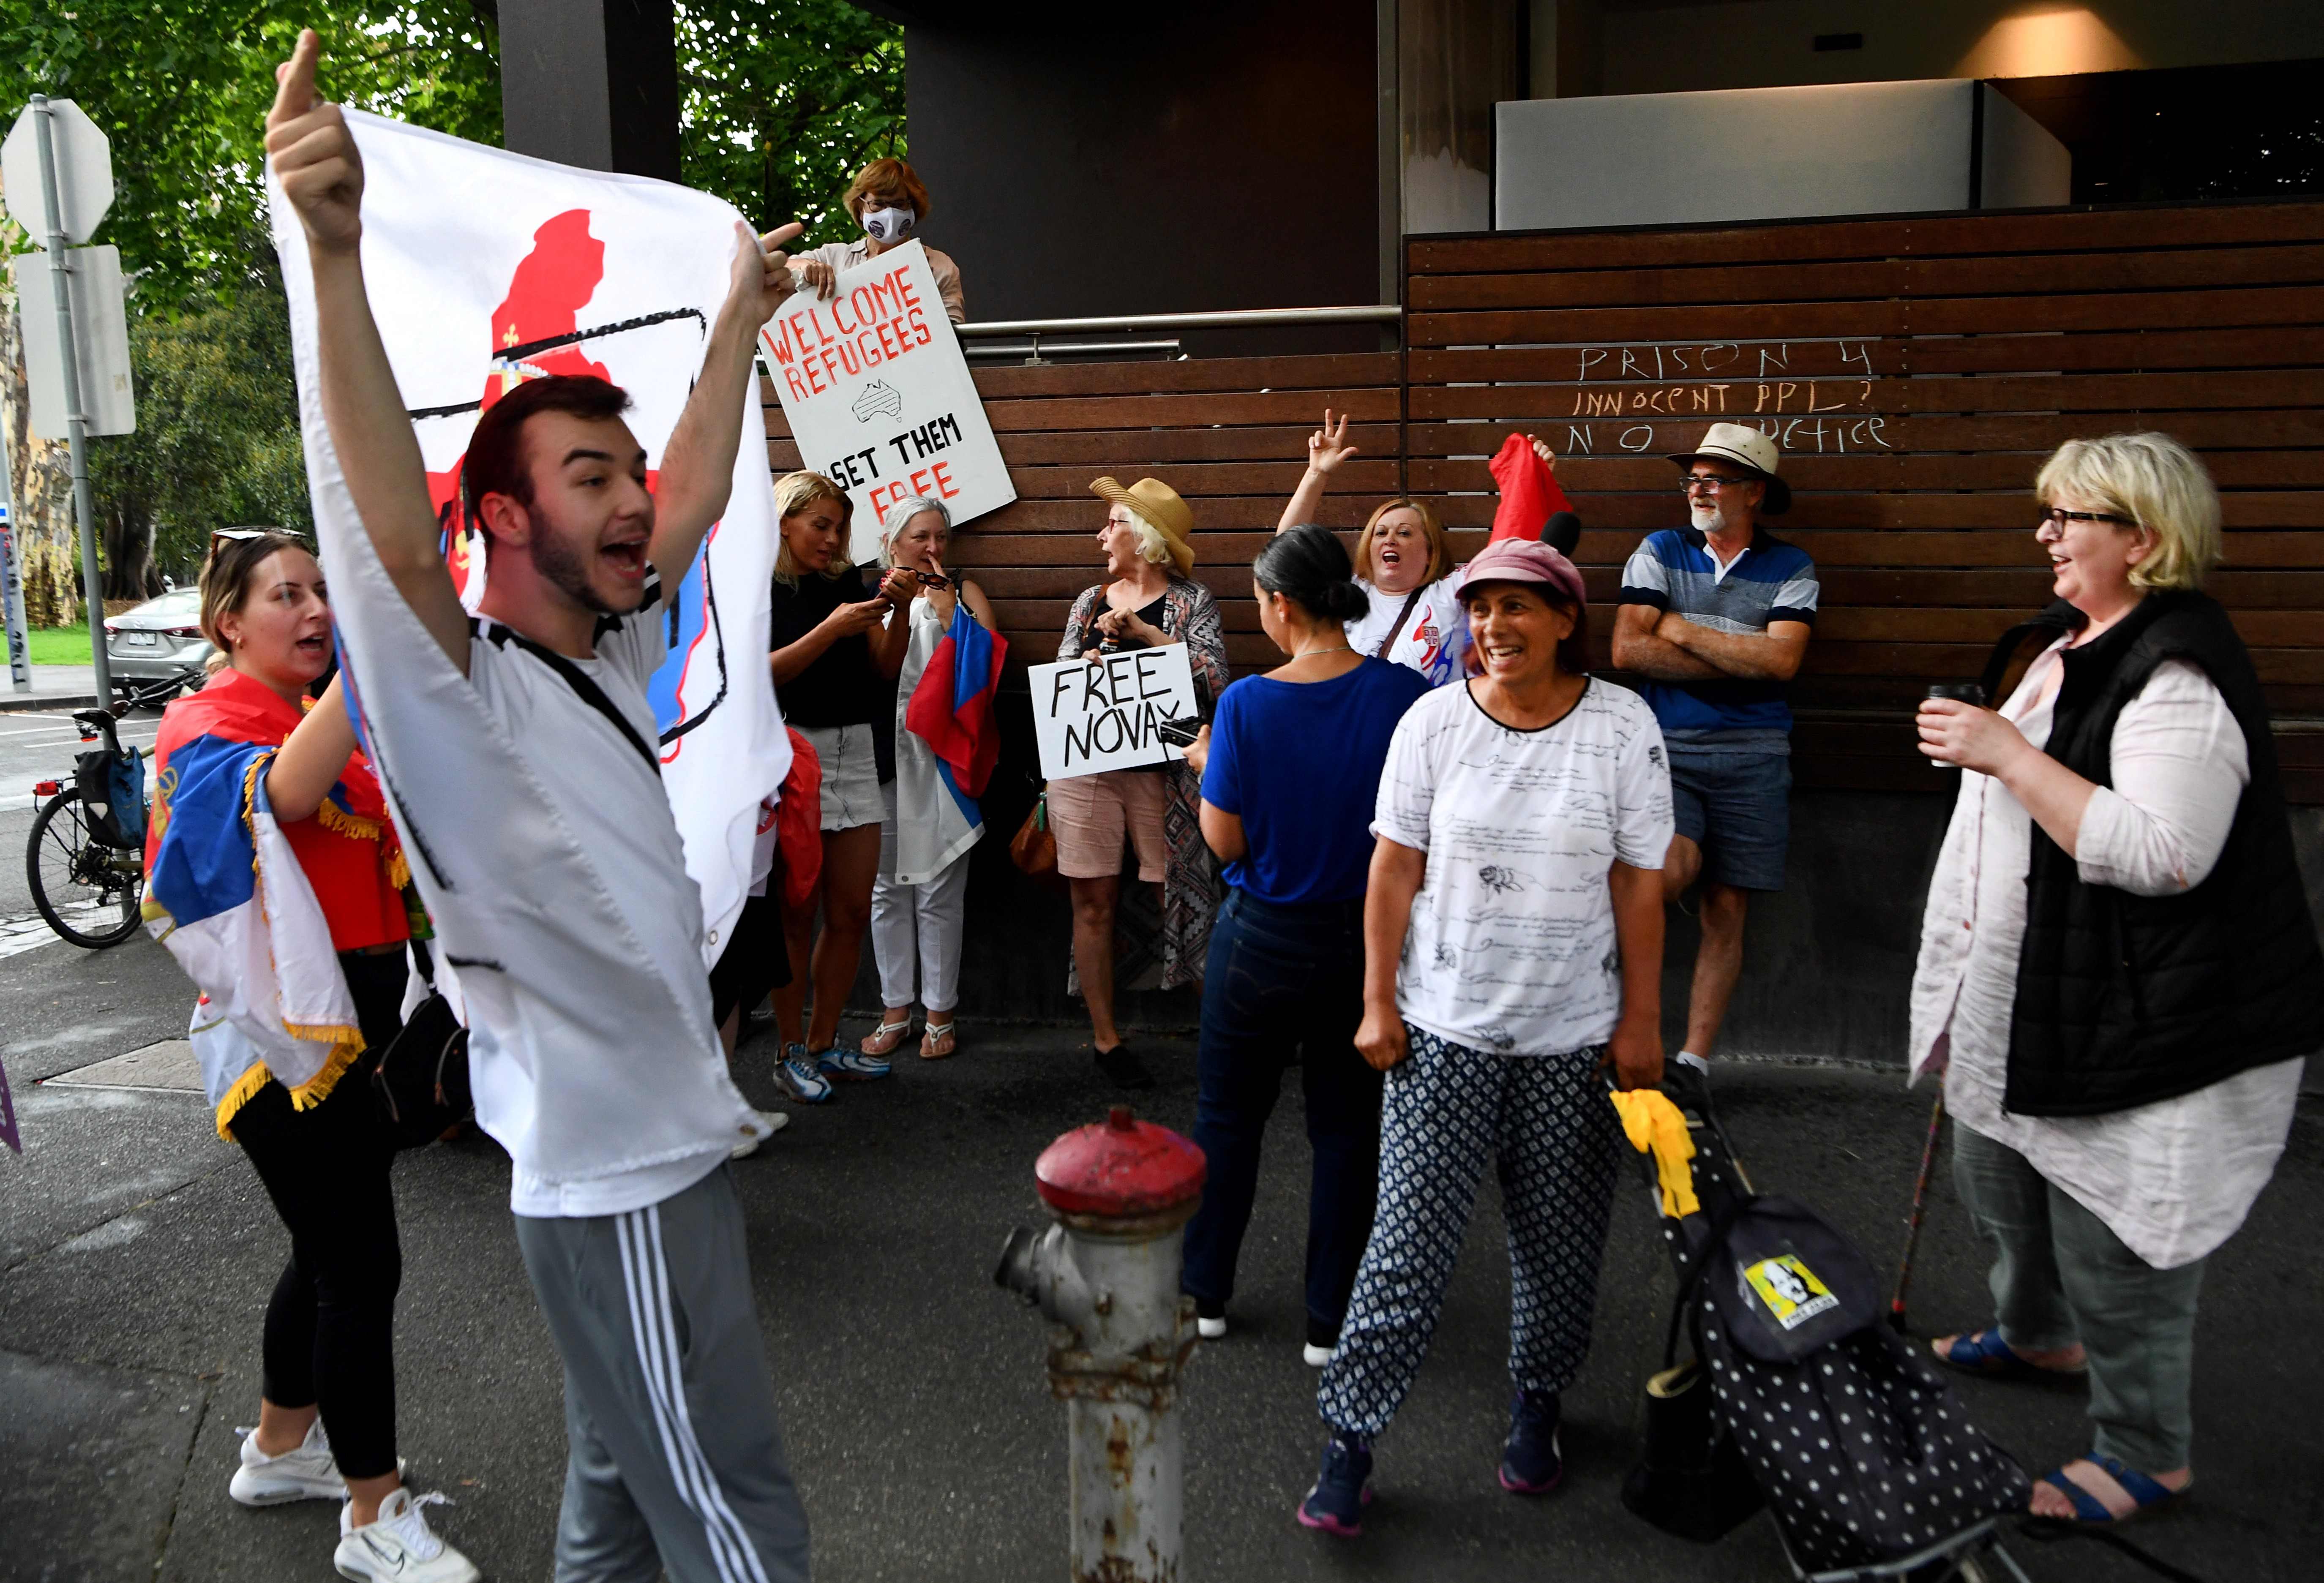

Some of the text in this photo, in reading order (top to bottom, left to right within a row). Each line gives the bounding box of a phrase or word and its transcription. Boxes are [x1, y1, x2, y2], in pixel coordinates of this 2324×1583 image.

[761, 264, 920, 365] WELCOME
[784, 307, 932, 403] REFUGEES
[1577, 343, 1789, 381] PRISON
[889, 413, 962, 465] THEM
[1567, 424, 1653, 454] NO
[1051, 651, 1172, 718] FREE
